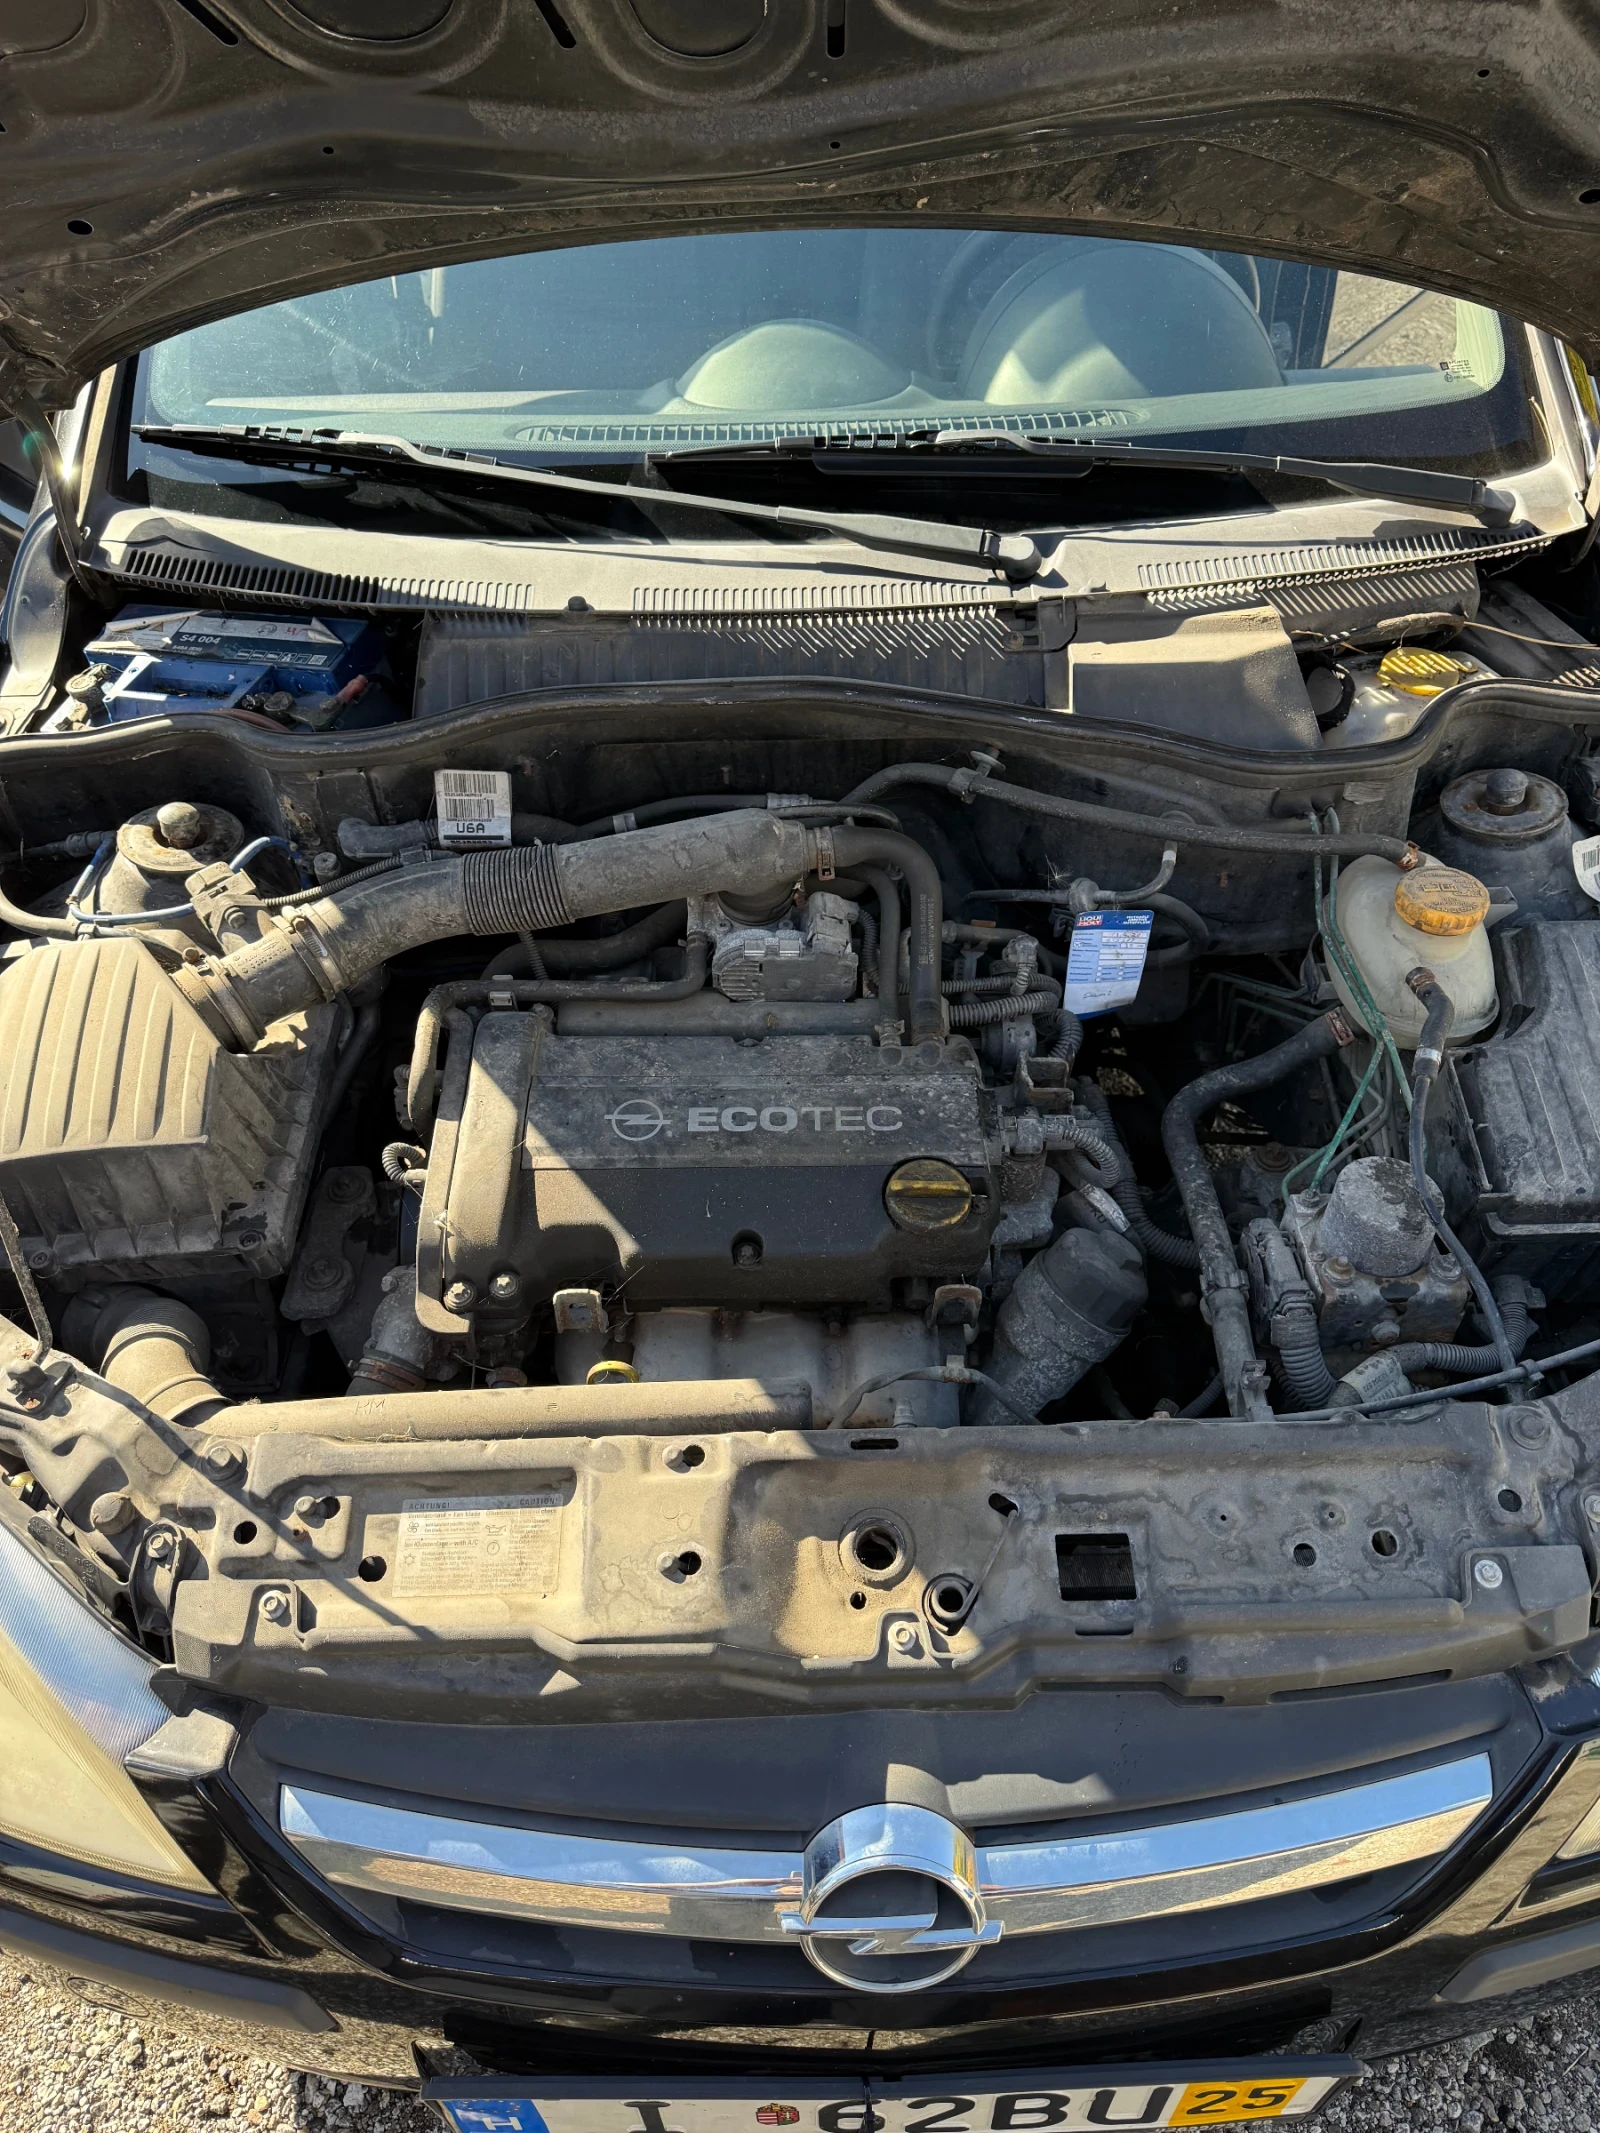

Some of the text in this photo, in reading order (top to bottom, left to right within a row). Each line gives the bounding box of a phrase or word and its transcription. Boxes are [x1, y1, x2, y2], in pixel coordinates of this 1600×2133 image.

[180, 634, 221, 644] S4 004
[456, 822, 485, 834] U6A
[687, 1105, 903, 1133] ECOTEC
[408, 1502, 450, 1511] ACHTUNG!
[519, 1498, 558, 1506] CAUTION!
[1186, 2084, 1296, 2114] 25
[482, 2116, 524, 2131] H
